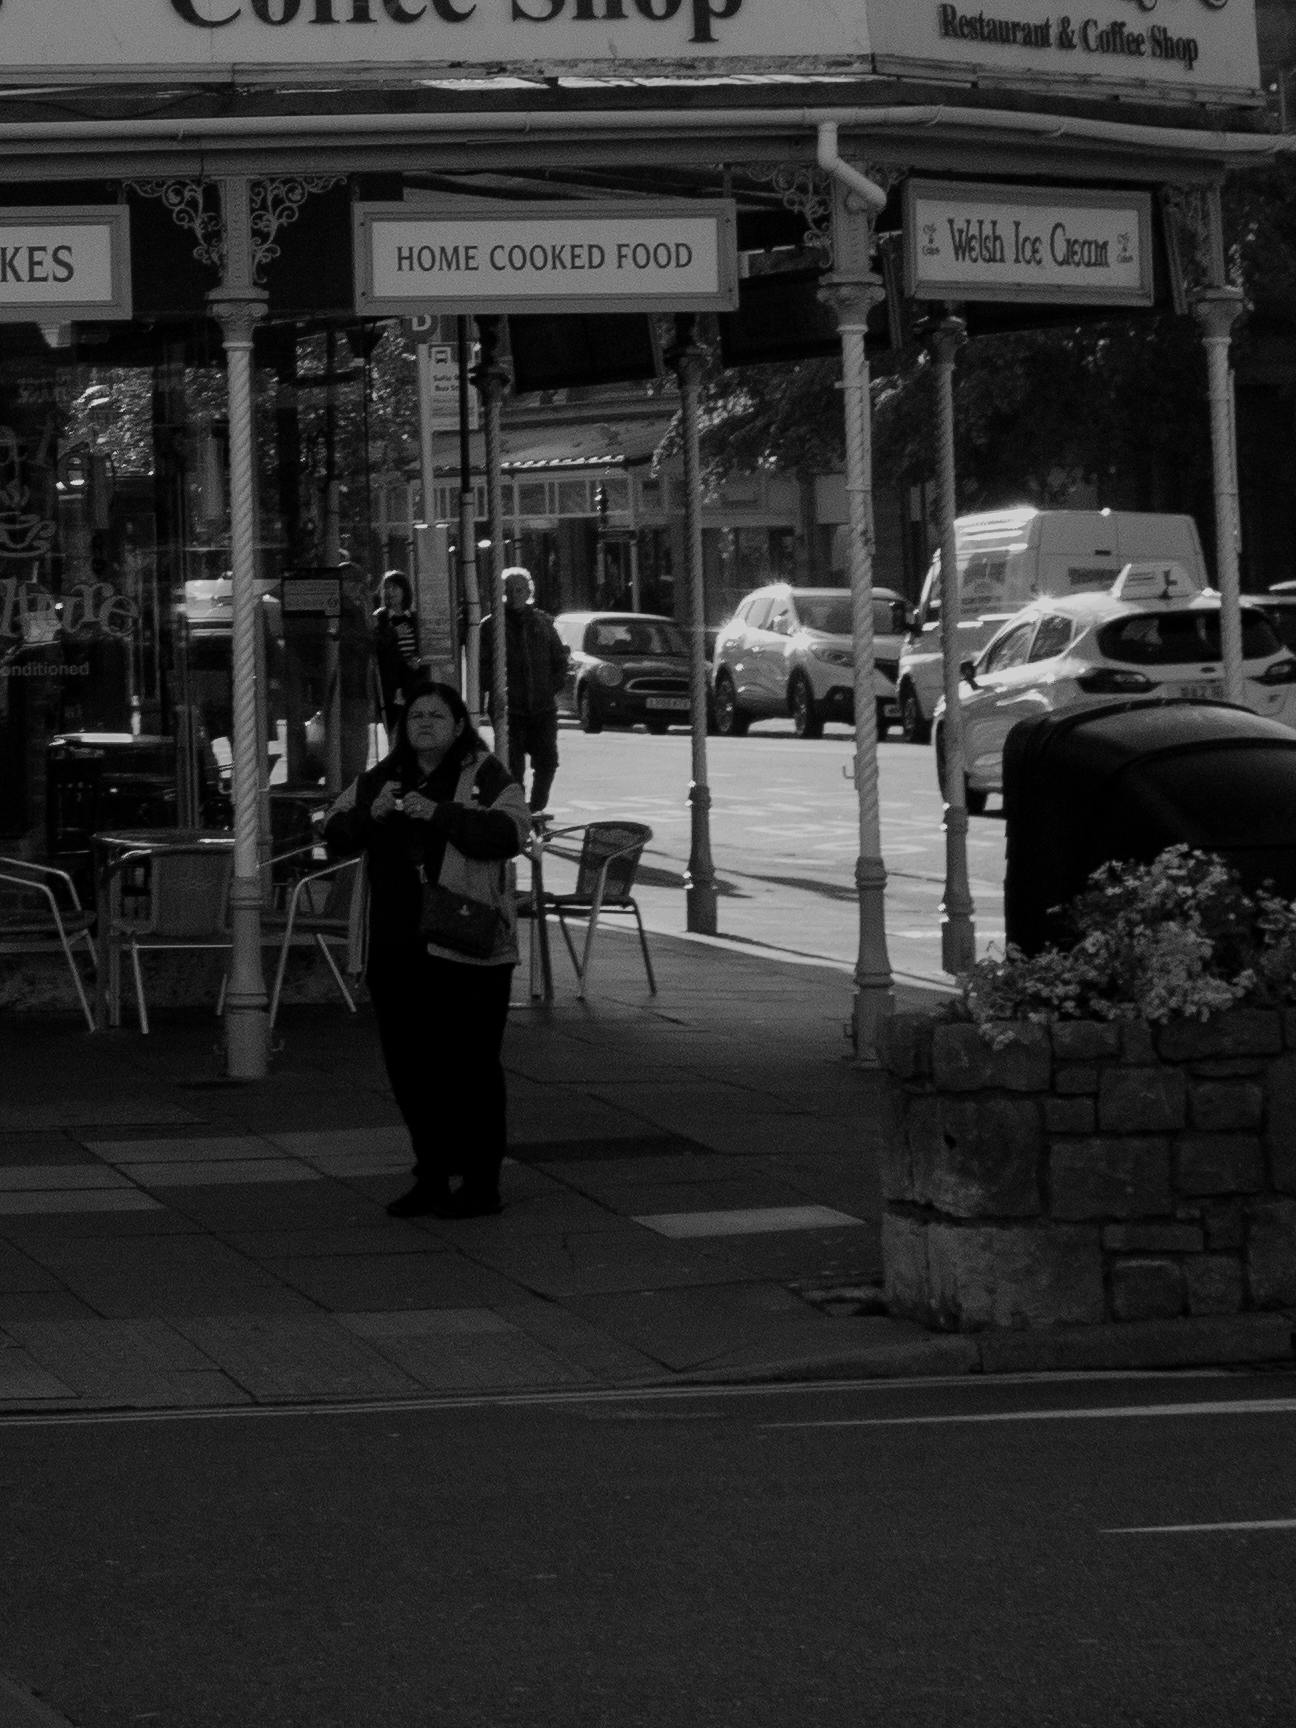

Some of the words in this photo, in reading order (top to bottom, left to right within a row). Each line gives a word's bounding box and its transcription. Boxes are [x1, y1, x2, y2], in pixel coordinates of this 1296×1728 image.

[939, 3, 1053, 49] Restaurant
[1059, 16, 1078, 51] &
[1081, 18, 1147, 57] Coffee
[1150, 24, 1199, 70] Shop
[396, 245, 479, 272] HOME
[489, 243, 606, 272] COOKED
[616, 242, 694, 271] FOOD
[948, 218, 1006, 264] Welsh
[1012, 220, 1043, 266] Ice
[1049, 222, 1111, 268] Cream
